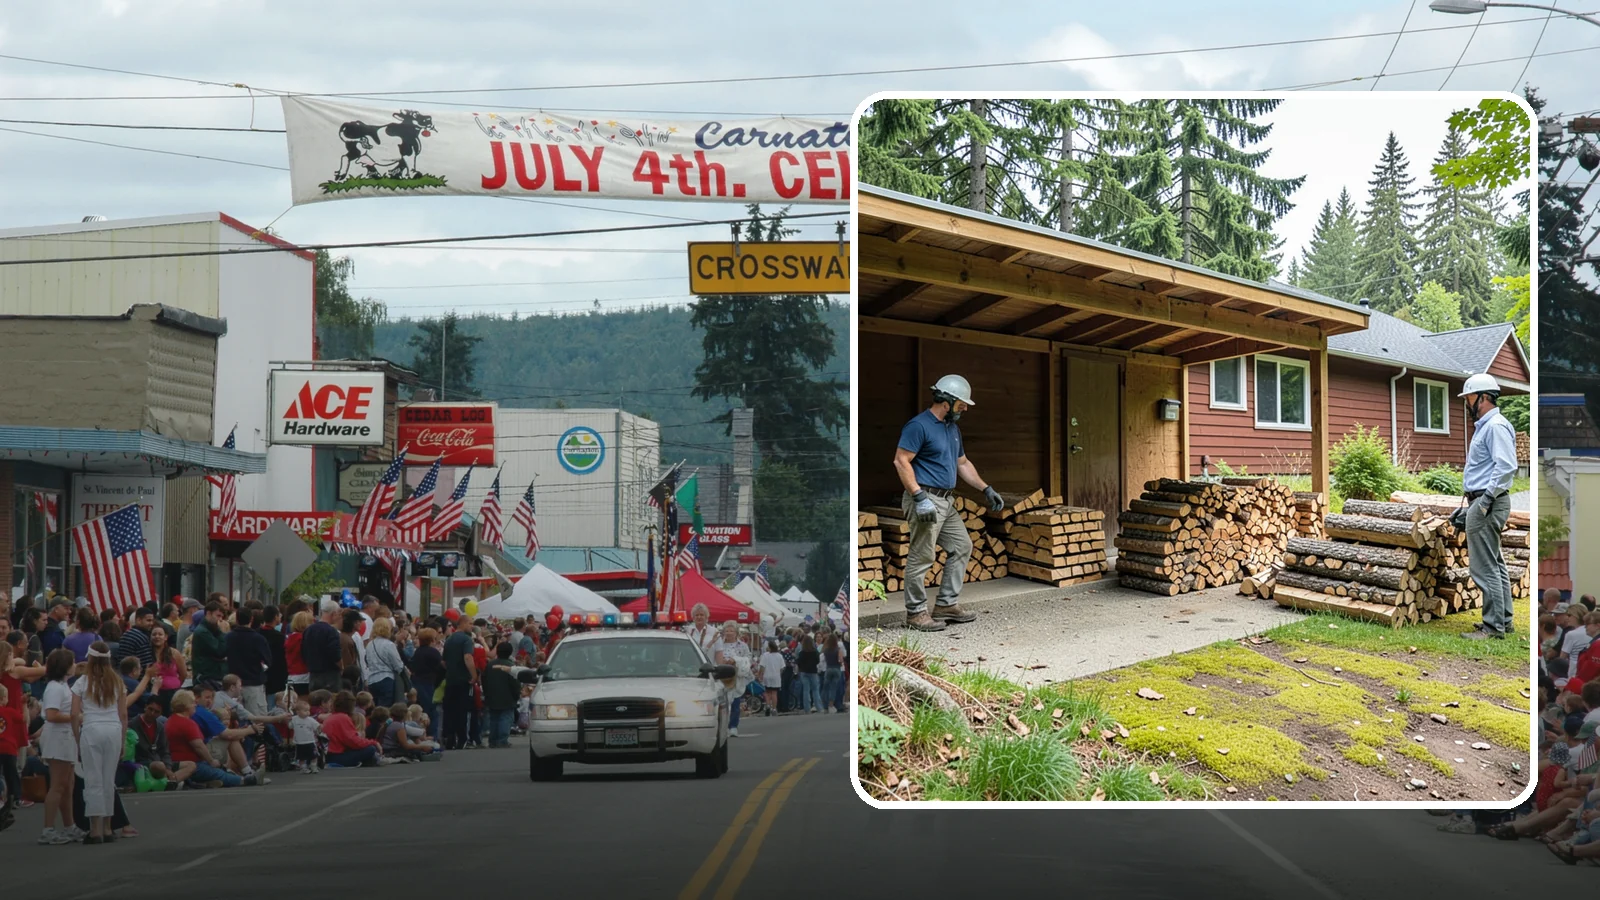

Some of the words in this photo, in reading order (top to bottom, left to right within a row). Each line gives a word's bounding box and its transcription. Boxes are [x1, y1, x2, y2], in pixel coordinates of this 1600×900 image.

[694, 121, 850, 150] Carnat
[481, 141, 604, 193] JULY
[632, 149, 746, 198] 4th.
[697, 254, 850, 281] CROSSWA
[282, 380, 373, 420] ACE
[405, 409, 452, 422] CEDAR
[461, 409, 485, 421] LOG
[283, 421, 371, 436] Hardware
[353, 467, 386, 481] Simpl
[83, 485, 94, 494] St.
[96, 485, 124, 495] Vincent
[126, 486, 136, 495] de
[138, 486, 155, 495] Paul
[688, 526, 742, 535] CRNATION
[699, 535, 731, 544] GLASS
